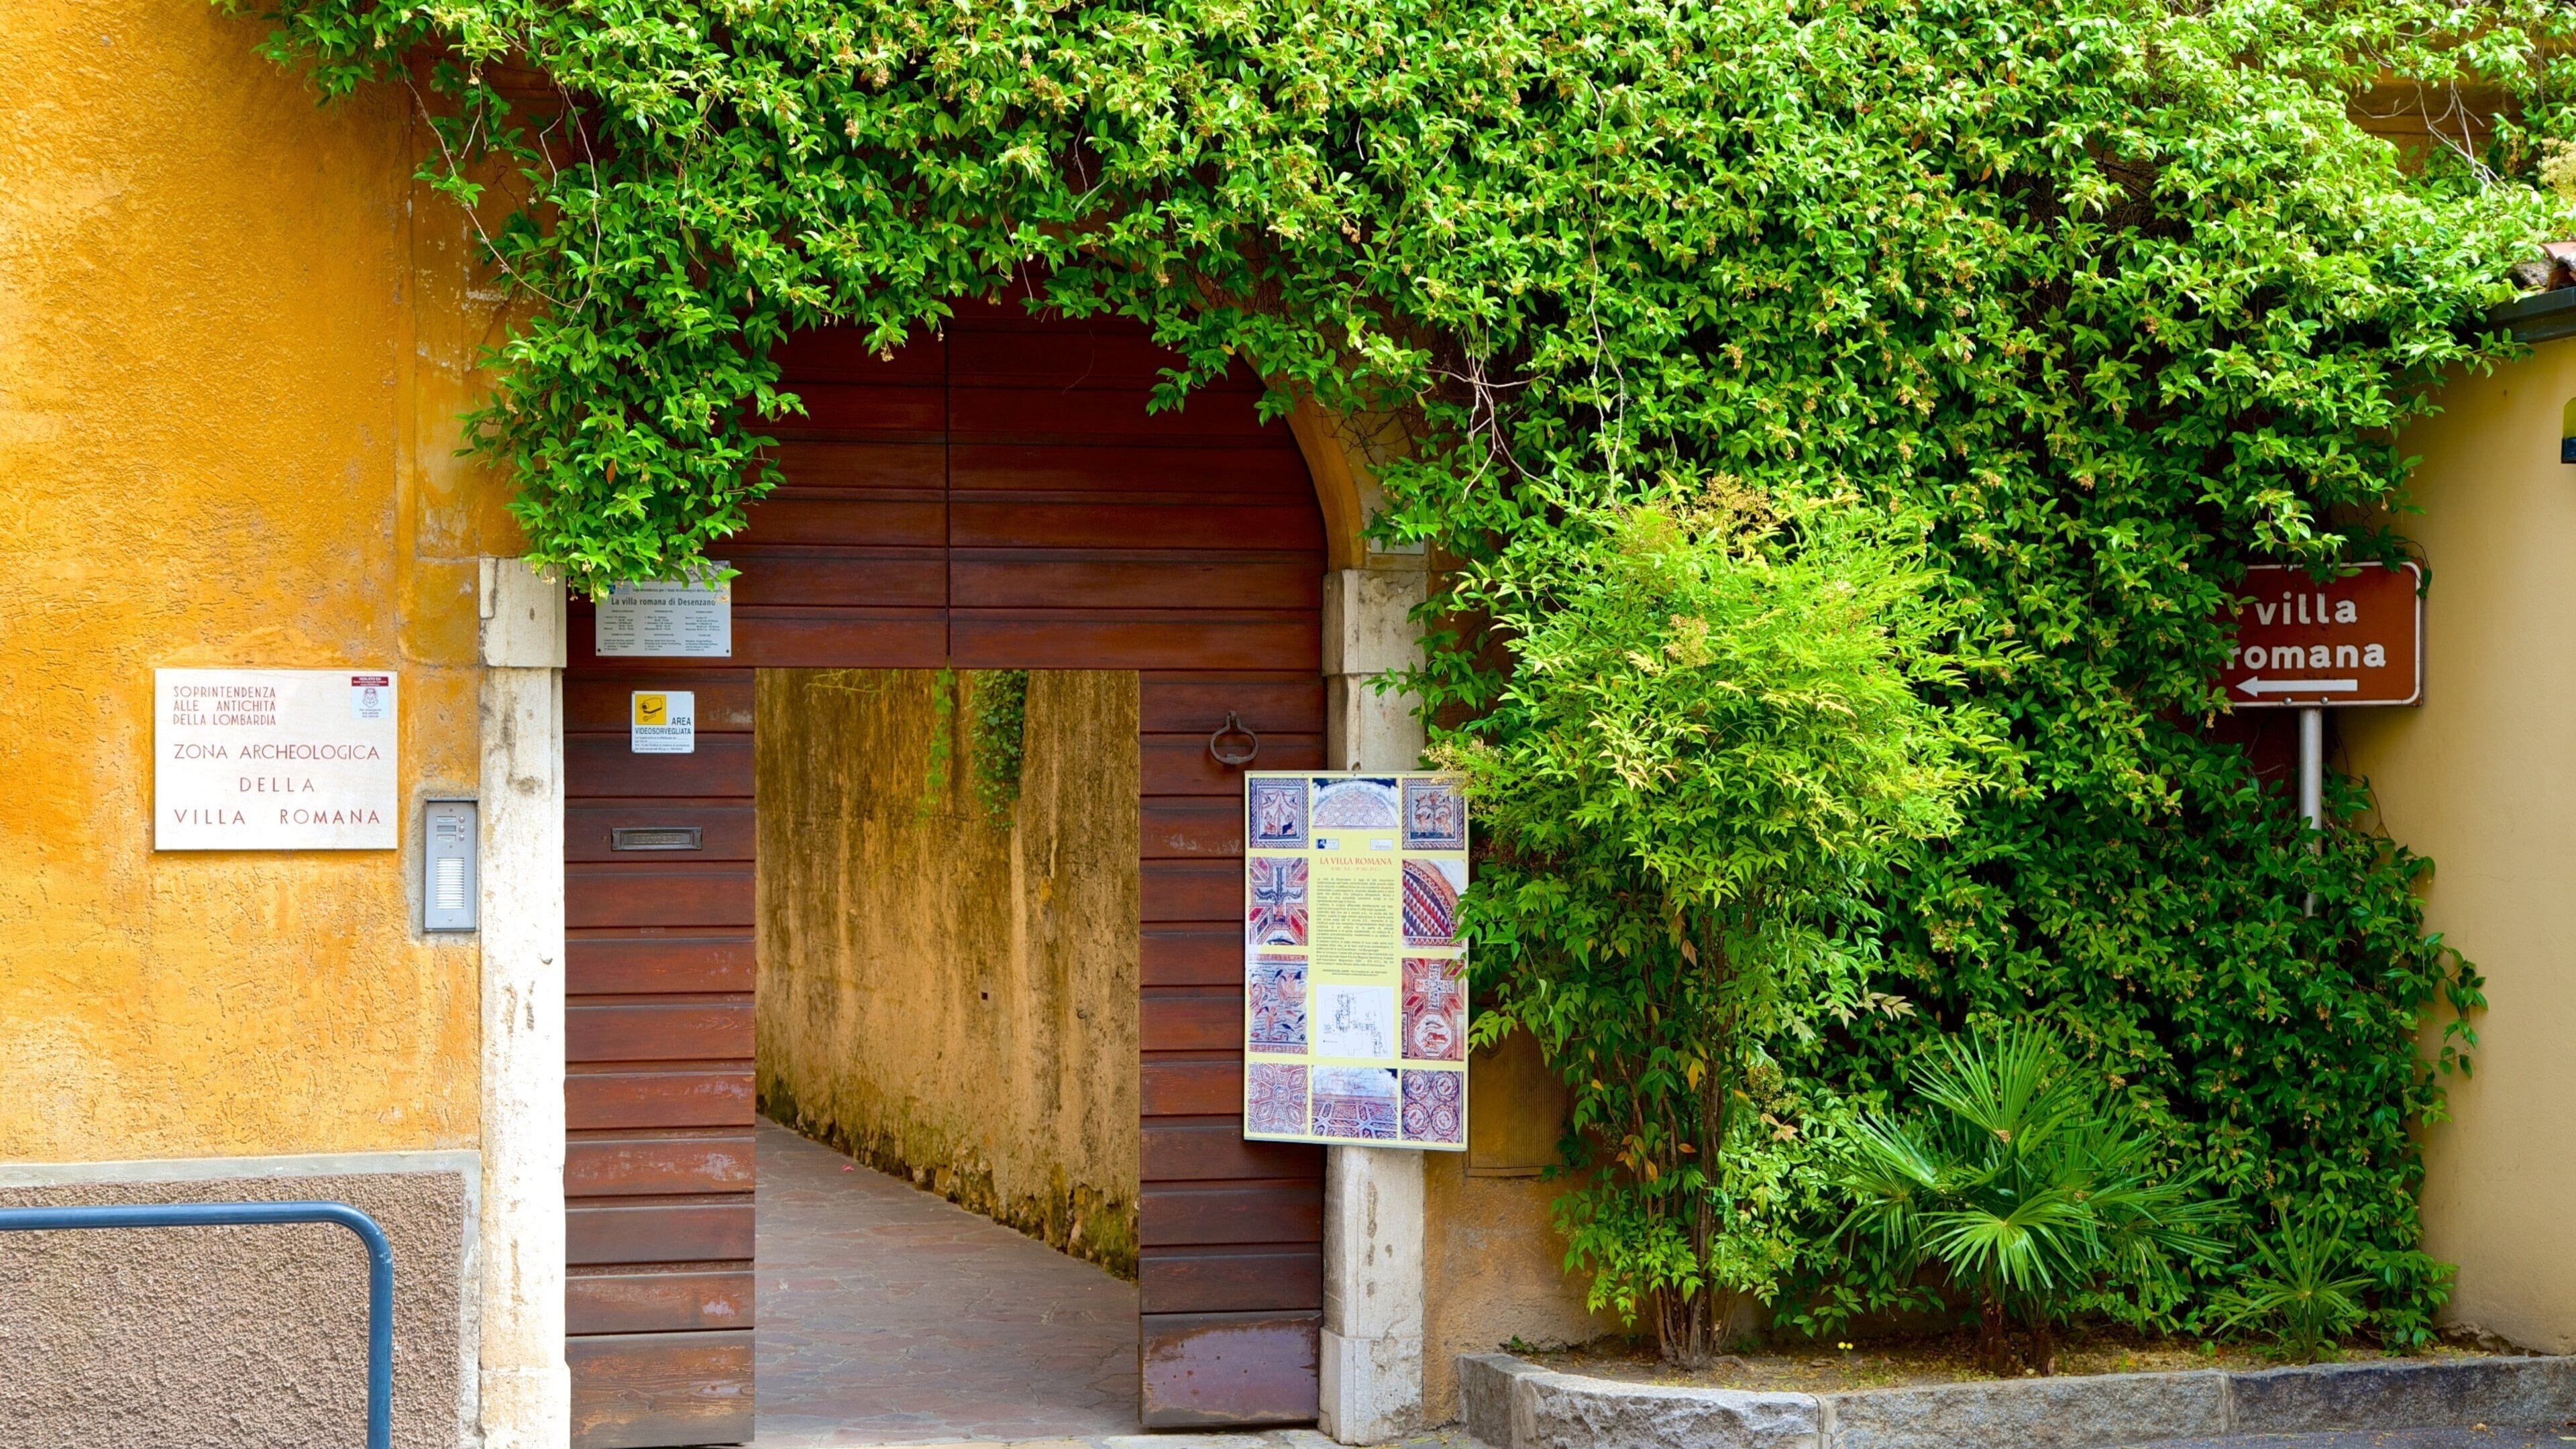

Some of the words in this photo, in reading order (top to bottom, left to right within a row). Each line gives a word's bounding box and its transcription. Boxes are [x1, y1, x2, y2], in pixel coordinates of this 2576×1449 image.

[622, 597, 637, 605] villa
[669, 597, 676, 606] di
[2255, 591, 2357, 625] villa
[2226, 643, 2387, 670] romana
[173, 686, 276, 698] SOPRINTENDENZA
[173, 700, 199, 712] ALLE
[172, 713, 206, 726] DELLA
[213, 713, 276, 726] LOMBARDIA
[671, 717, 691, 725] AREA
[173, 744, 228, 759] ZONA
[239, 744, 380, 760] ARCHEOLOGICA
[239, 777, 315, 793] DELLA
[174, 808, 246, 825] VILLA
[280, 808, 380, 825] ROMANA
[1355, 857, 1392, 865] ROMANA
